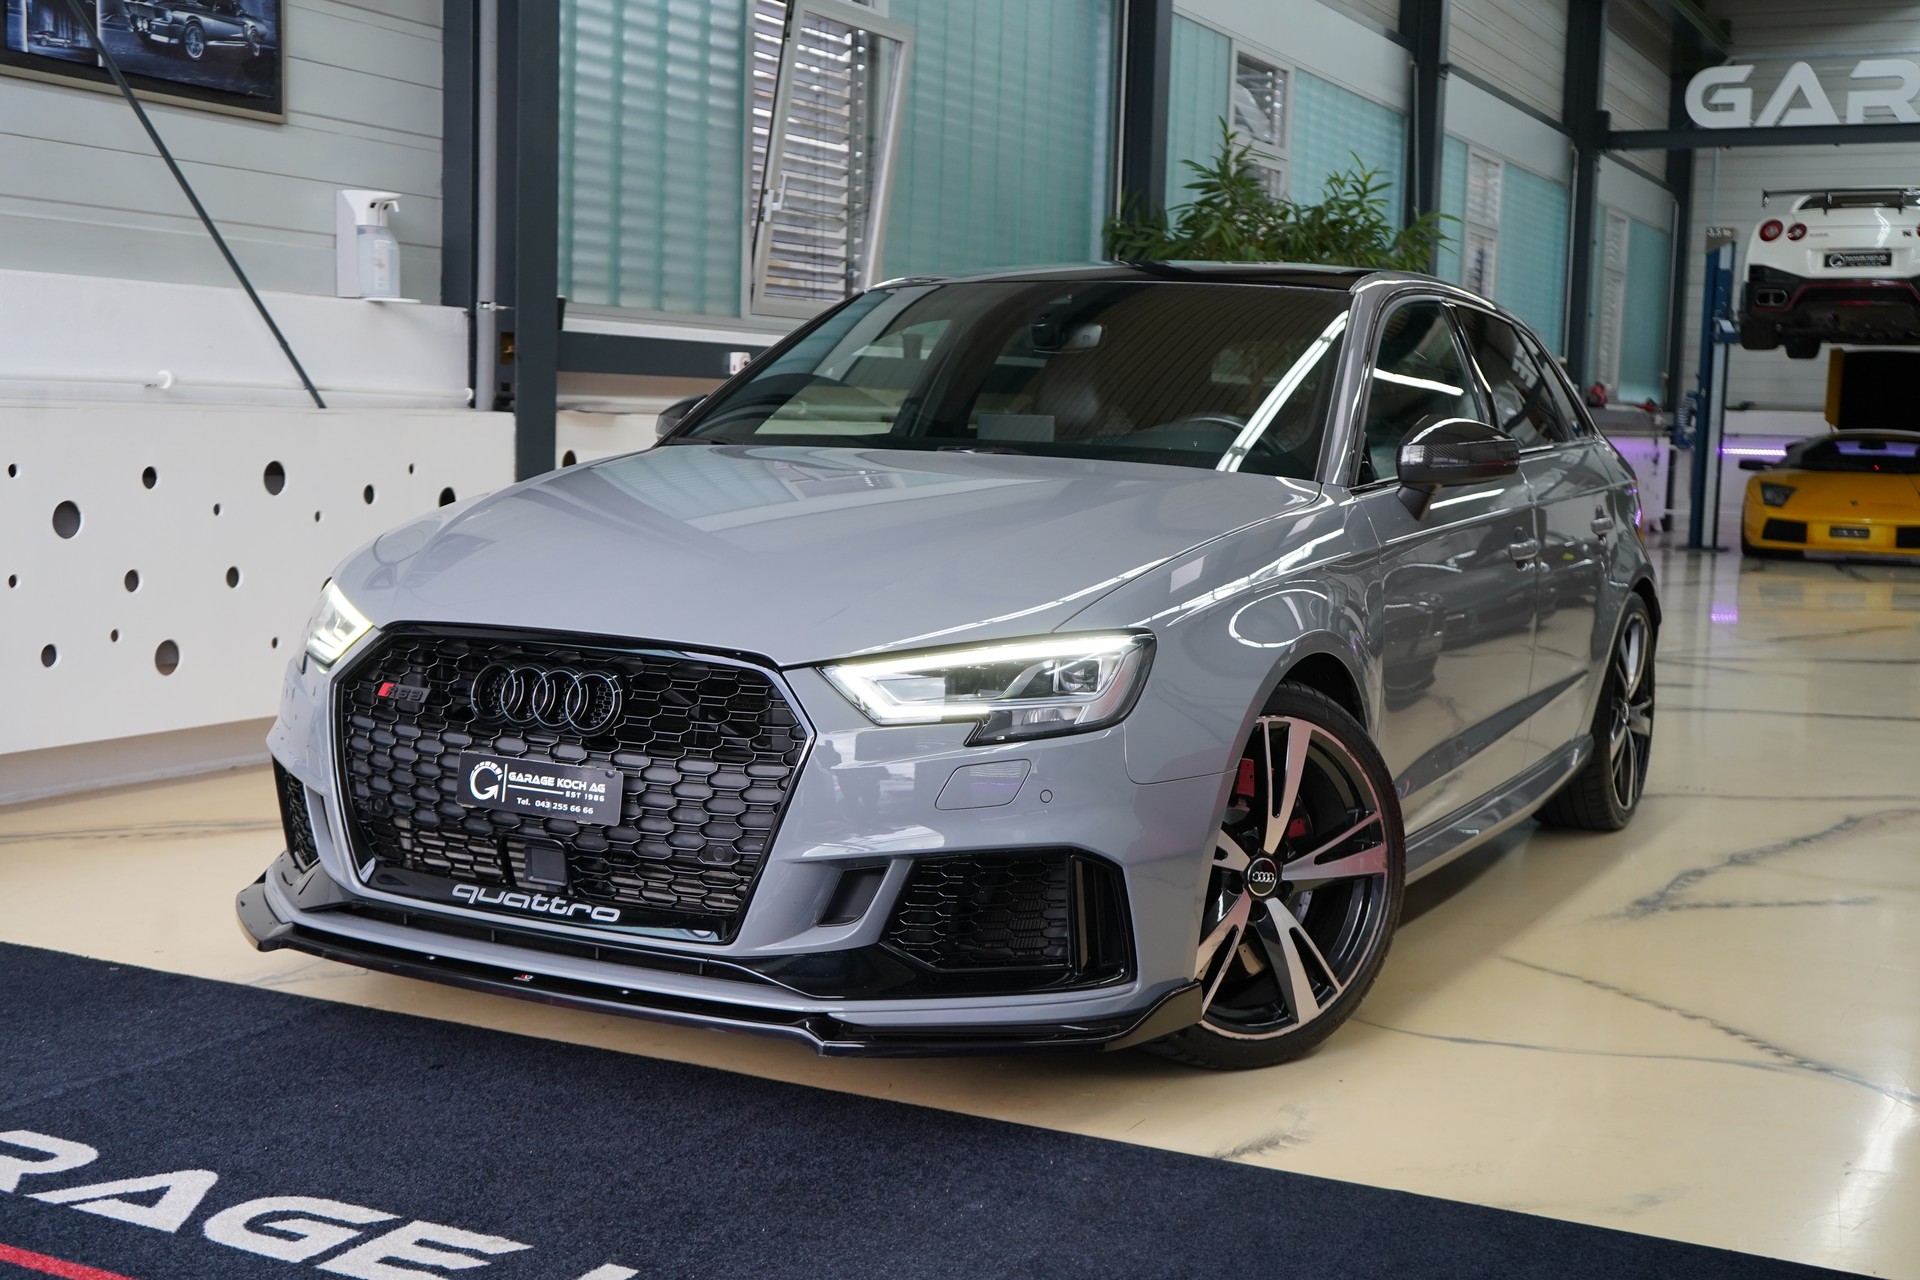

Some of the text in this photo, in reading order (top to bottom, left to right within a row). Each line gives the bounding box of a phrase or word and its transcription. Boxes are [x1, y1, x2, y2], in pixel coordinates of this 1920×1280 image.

[1685, 59, 1920, 129] GAR
[508, 772, 606, 793] GARAGE KOCH AG
[517, 797, 594, 815] Tel. 043 255 66 66
[565, 791, 605, 802] EST 1986
[452, 883, 621, 922] quattro
